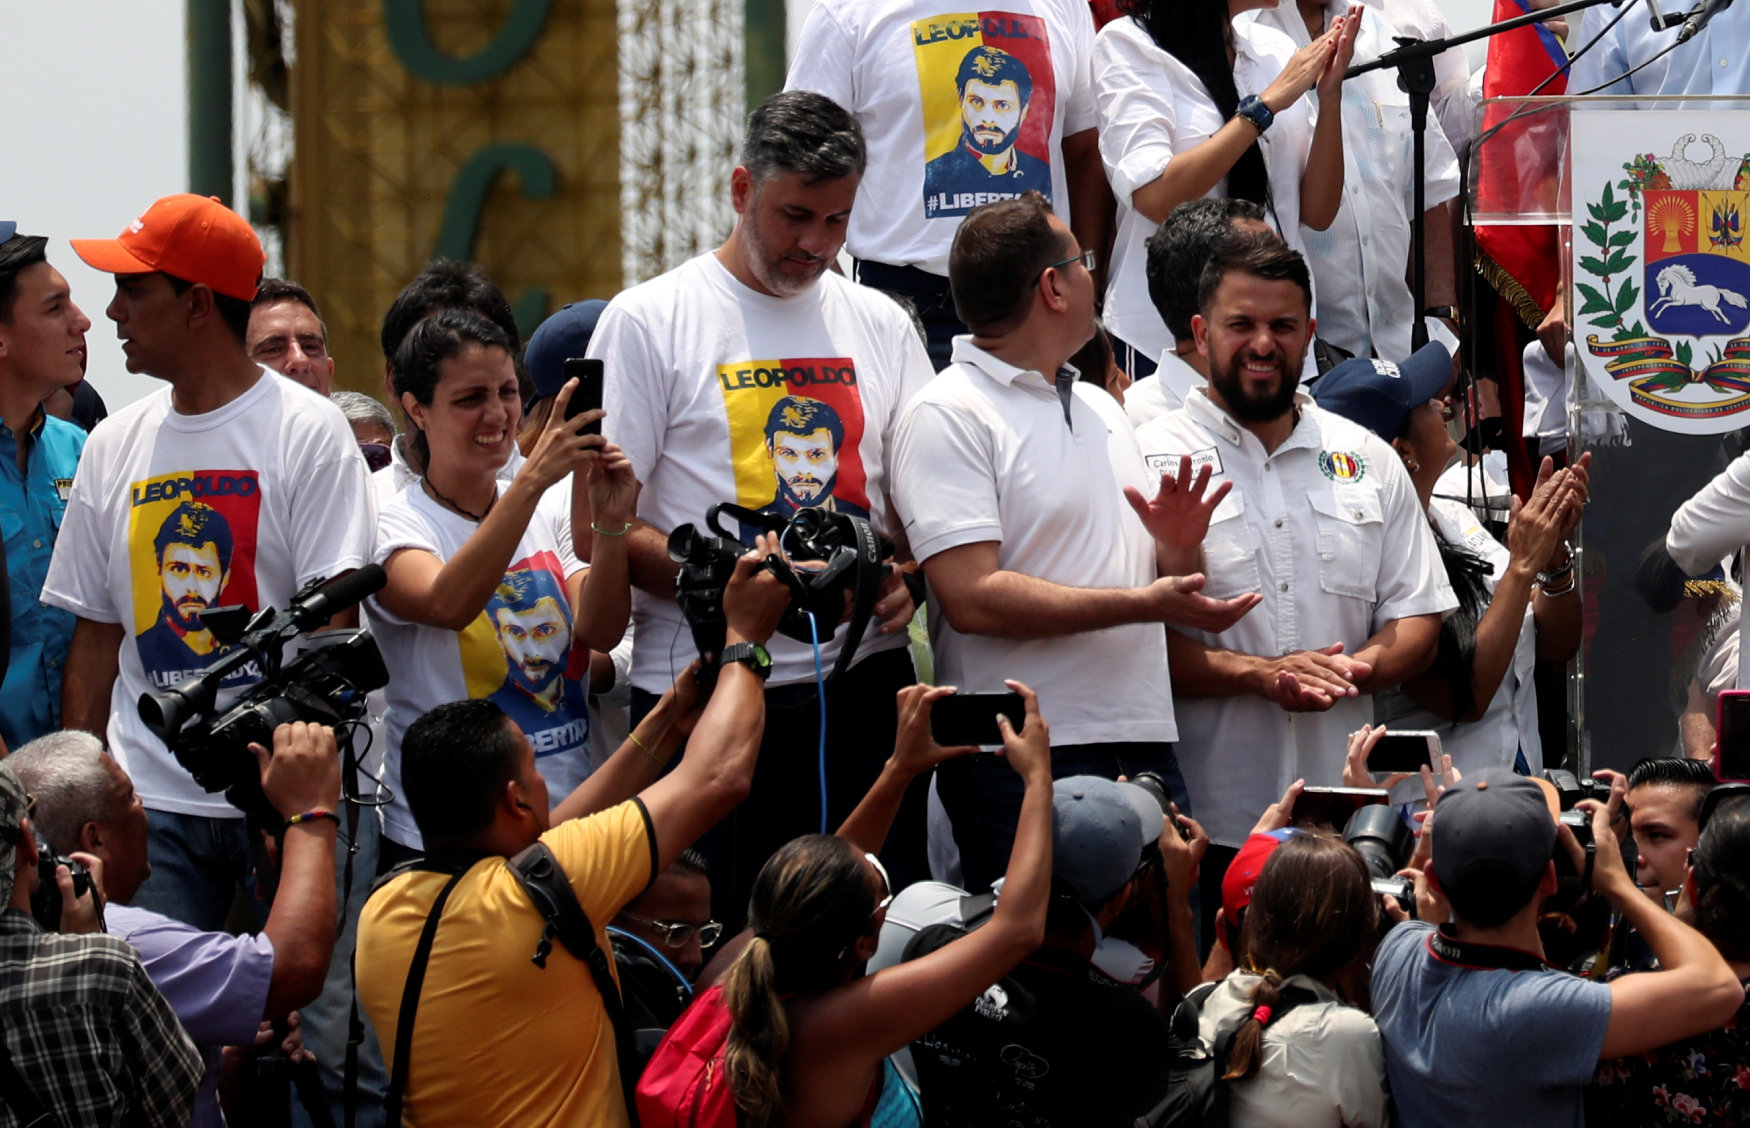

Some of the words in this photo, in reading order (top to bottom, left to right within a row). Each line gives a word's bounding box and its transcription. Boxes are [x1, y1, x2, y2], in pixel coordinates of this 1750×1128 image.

[720, 366, 857, 391] LEOPOLDO
[1153, 457, 1178, 468] Carlos
[133, 475, 256, 507] LEOPOLDO
[860, 522, 877, 563] Canon
